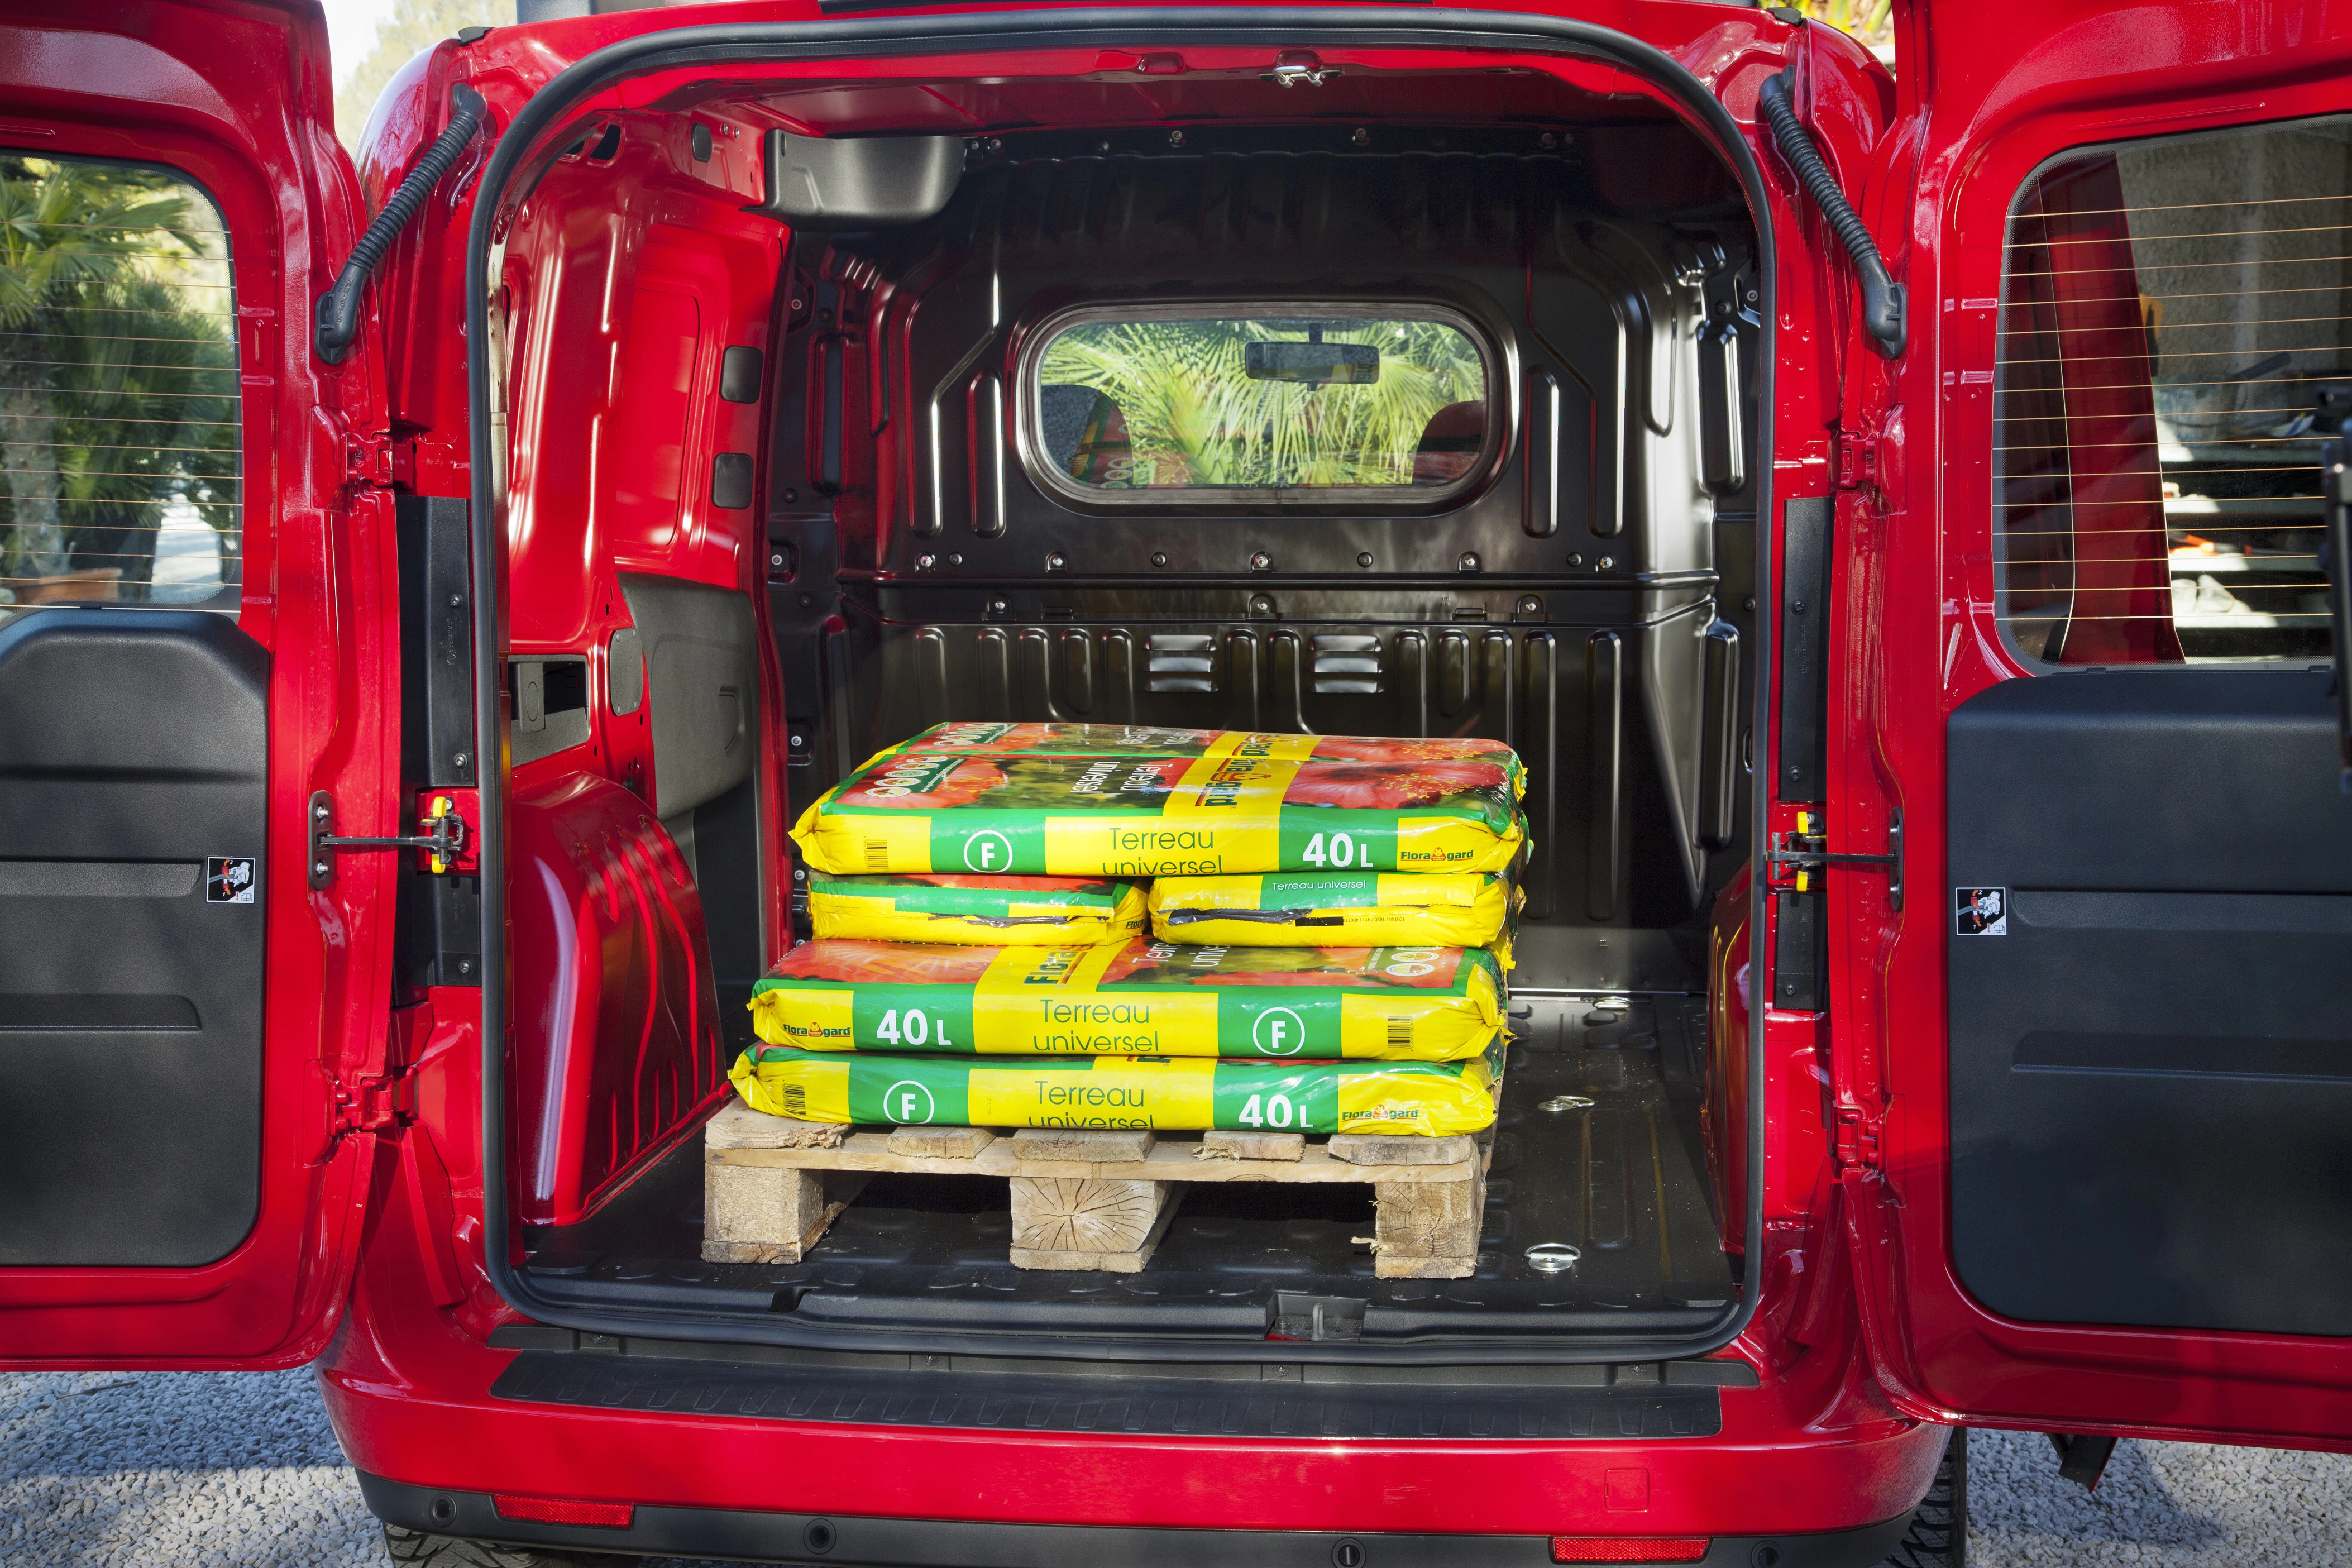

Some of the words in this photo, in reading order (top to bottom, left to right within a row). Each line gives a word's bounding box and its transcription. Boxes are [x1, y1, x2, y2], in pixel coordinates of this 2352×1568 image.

[1069, 762, 1121, 793] universel
[1120, 763, 1173, 791] Terreau
[1108, 827, 1213, 850] Terreau
[981, 842, 995, 868] F
[1103, 855, 1222, 874] universel
[1272, 882, 1314, 890] Terreau
[1317, 879, 1366, 890] universel
[1023, 952, 1079, 984] Flora
[1040, 999, 1149, 1024] Terreau
[1034, 1031, 1159, 1051] universel
[1271, 1021, 1286, 1049] F
[902, 1093, 916, 1120] F
[1035, 1081, 1144, 1107] Terreau
[1029, 1115, 1154, 1130] universel
